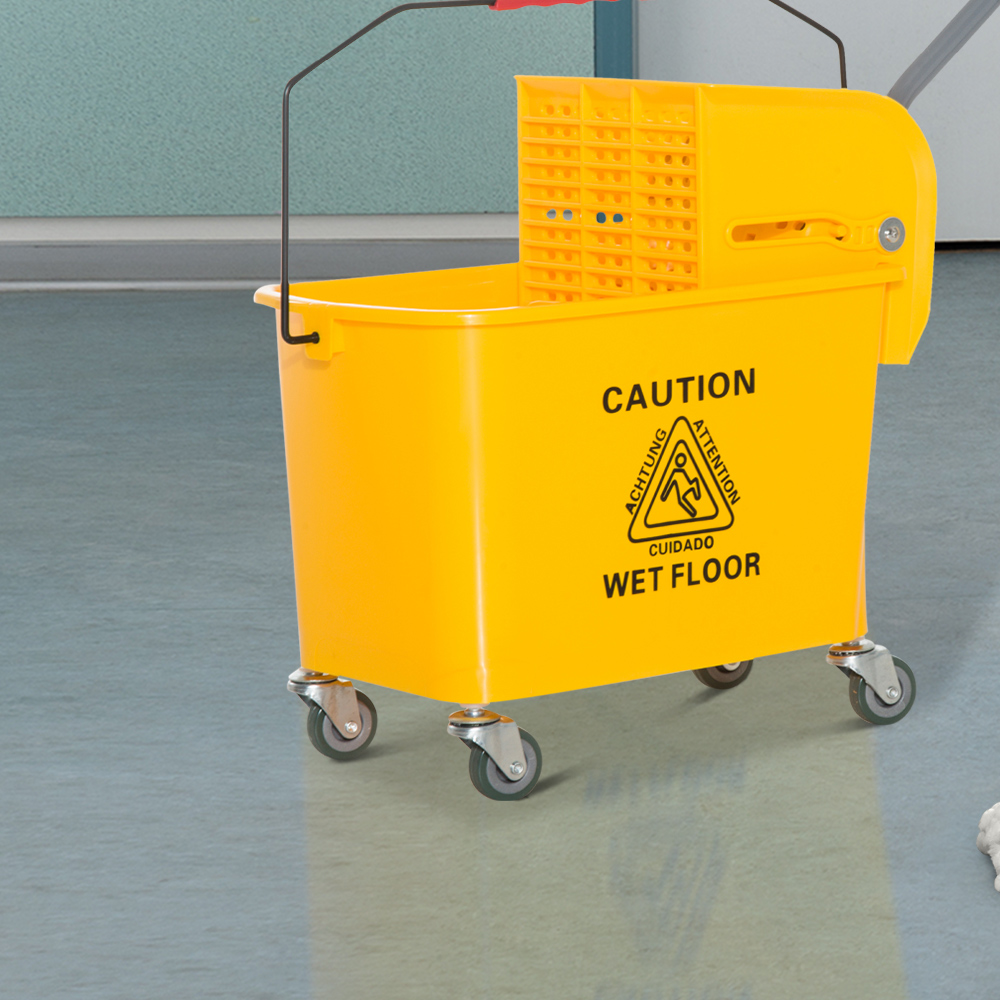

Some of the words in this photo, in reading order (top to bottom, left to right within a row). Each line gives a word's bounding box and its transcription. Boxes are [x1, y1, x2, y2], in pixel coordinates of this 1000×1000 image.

[602, 367, 756, 414] CAUTION
[625, 428, 668, 515] ACHTUNG
[692, 419, 741, 506] ATTENTION
[648, 535, 715, 557] CUIDADO
[603, 565, 664, 599] WET
[671, 552, 761, 589] FLOOR
